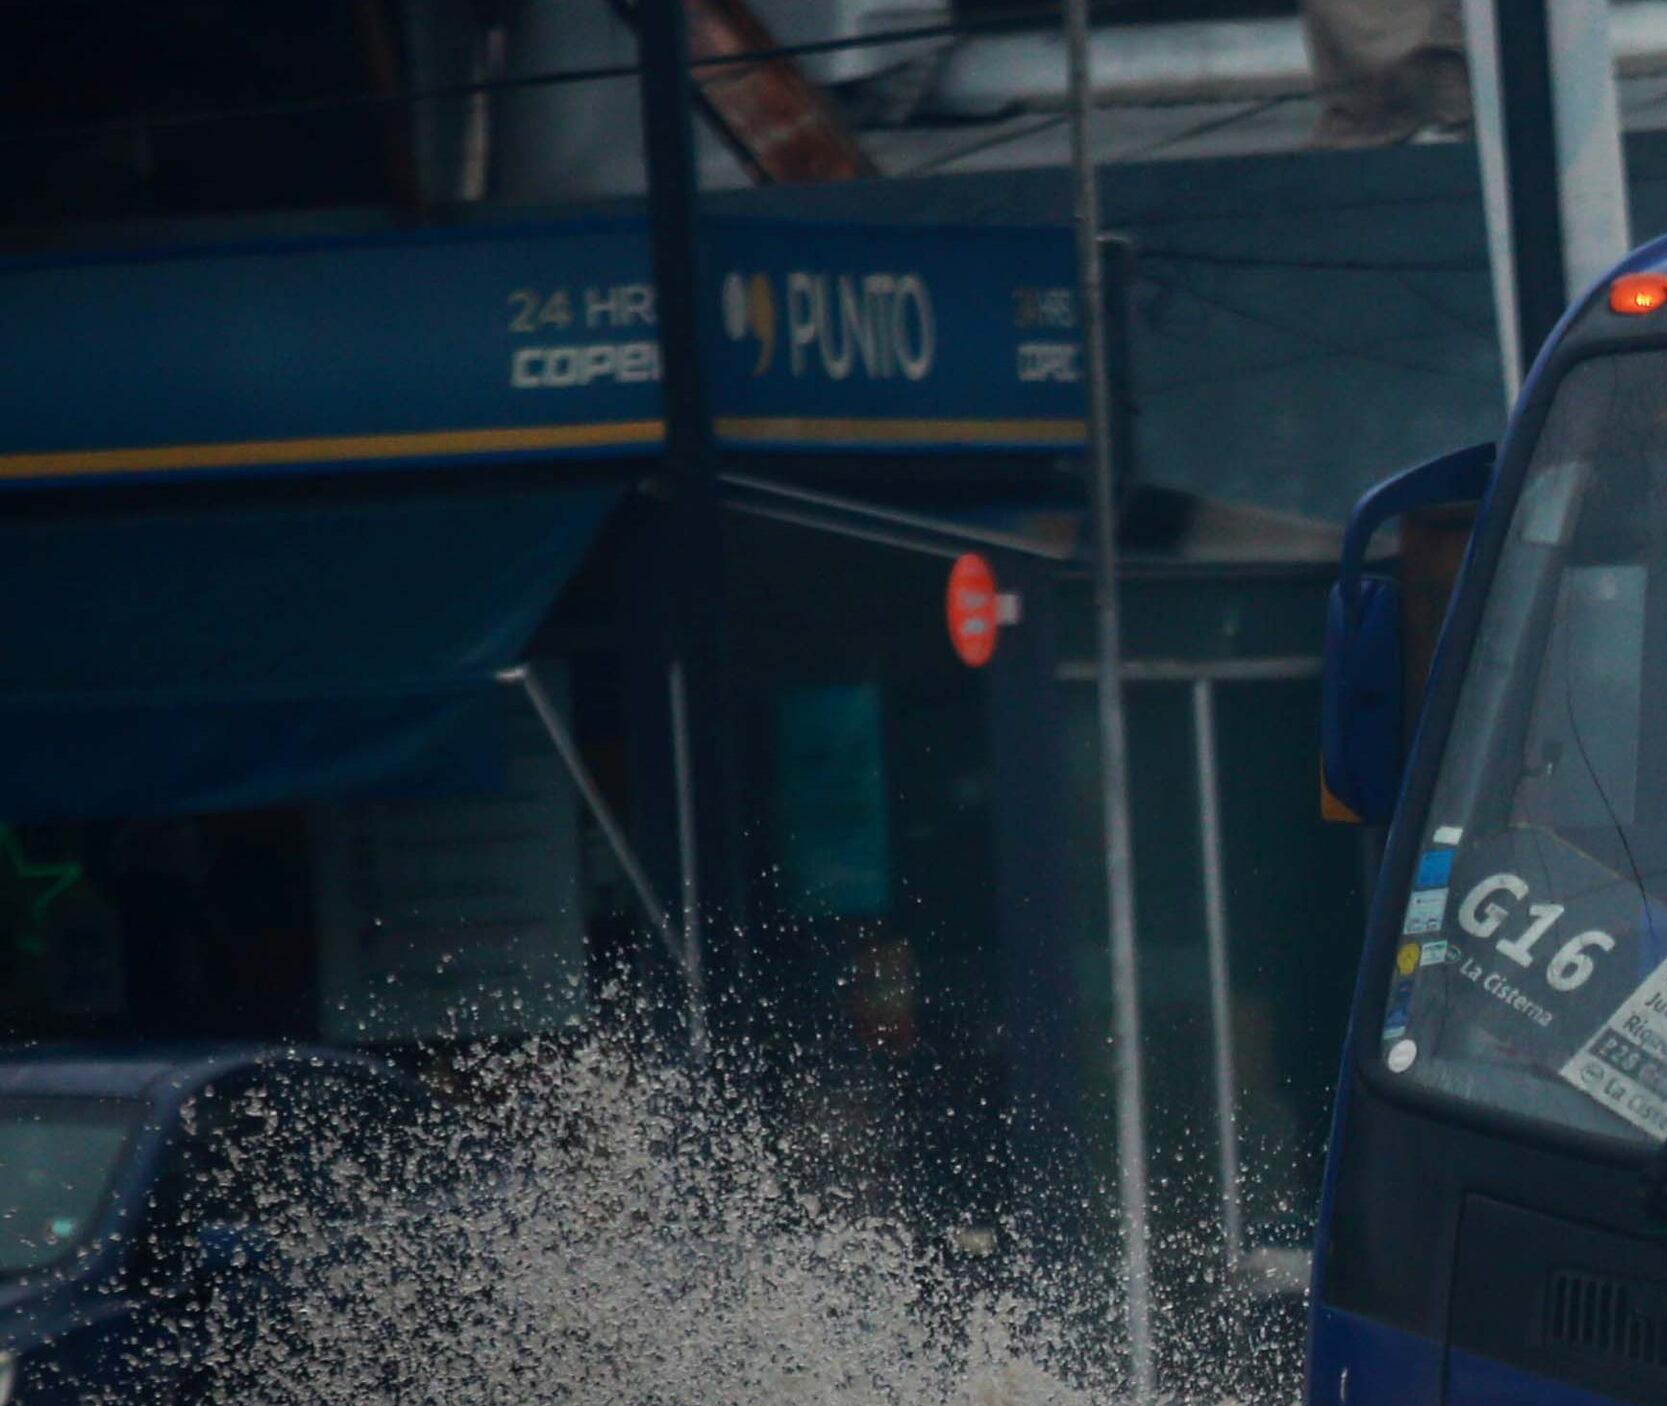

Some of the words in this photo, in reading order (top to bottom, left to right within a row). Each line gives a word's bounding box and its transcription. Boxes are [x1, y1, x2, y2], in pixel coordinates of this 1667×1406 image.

[508, 287, 573, 333] 24
[584, 283, 658, 328] HR
[786, 272, 934, 380] PUNTO
[511, 340, 664, 389] COPE
[1458, 873, 1615, 992] G16
[1458, 957, 1483, 982] La
[1483, 973, 1553, 1027] Cisterna
